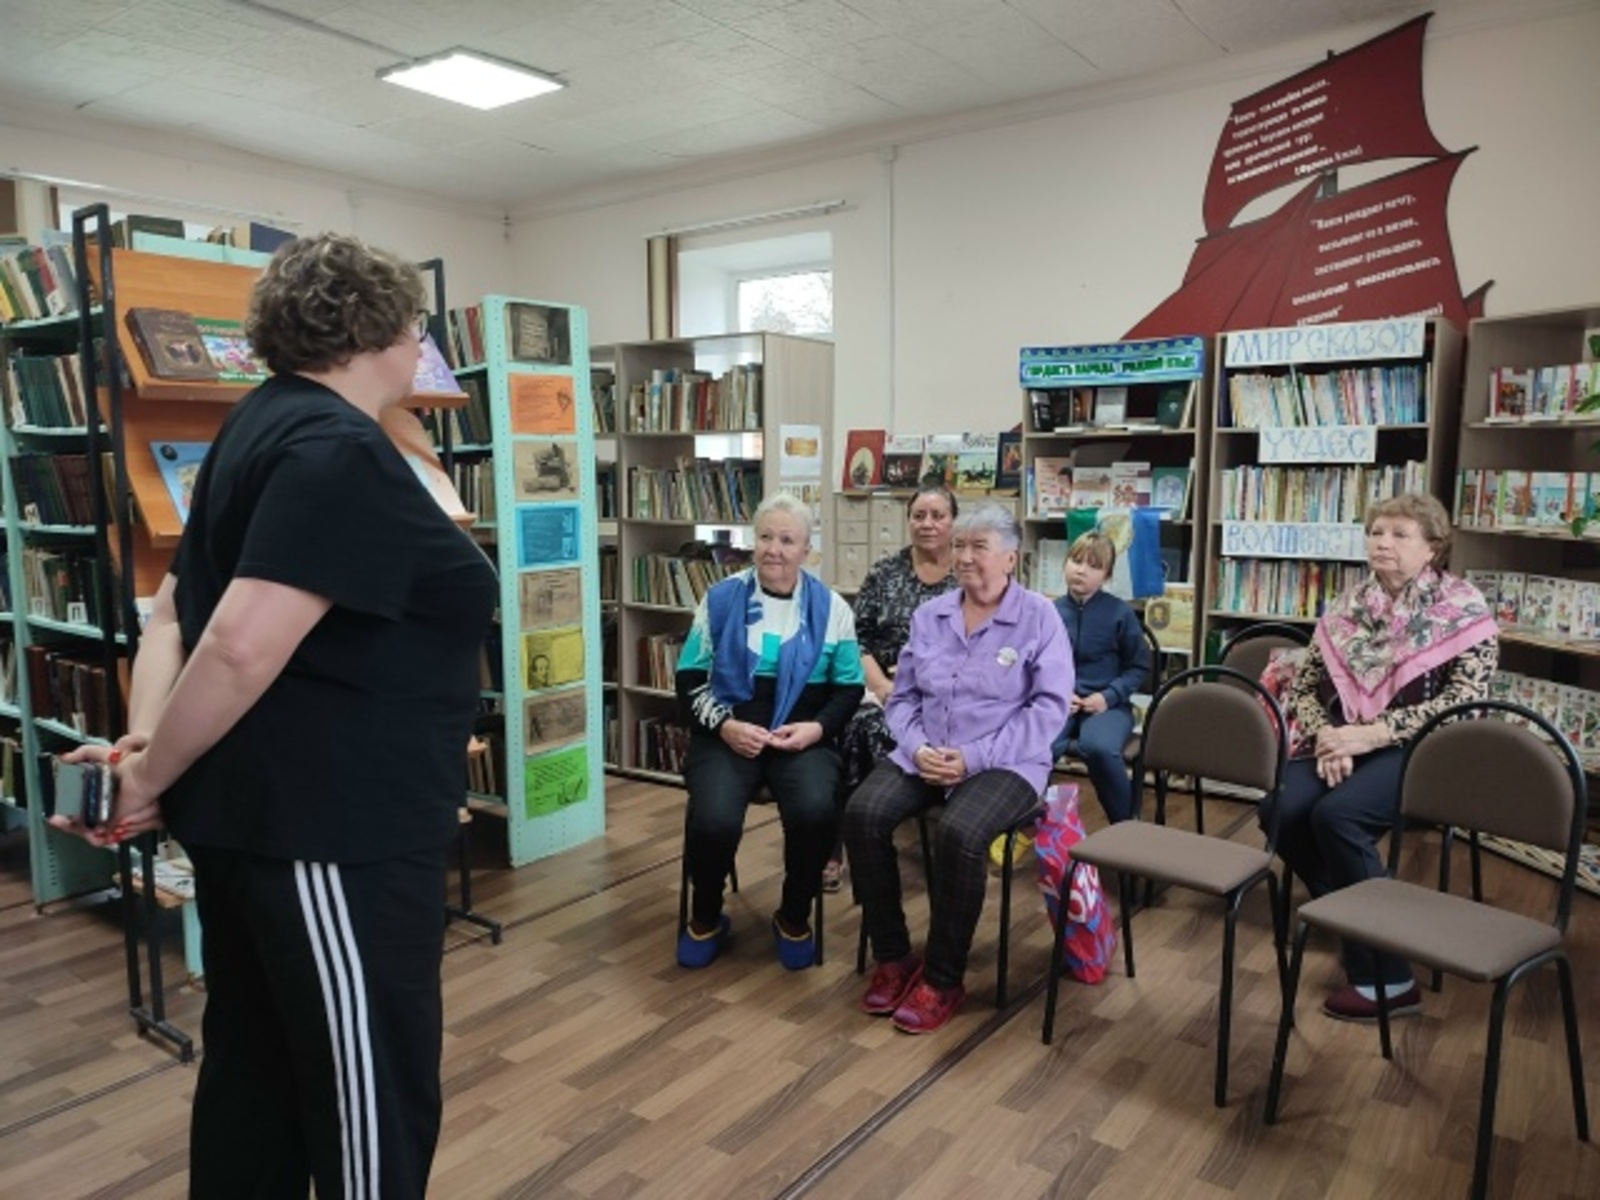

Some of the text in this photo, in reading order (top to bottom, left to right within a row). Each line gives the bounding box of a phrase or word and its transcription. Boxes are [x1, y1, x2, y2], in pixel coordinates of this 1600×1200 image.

[1231, 322, 1419, 363] МИР СКАЗОК
[1226, 523, 1362, 557] ВОЛШЕБСТ
